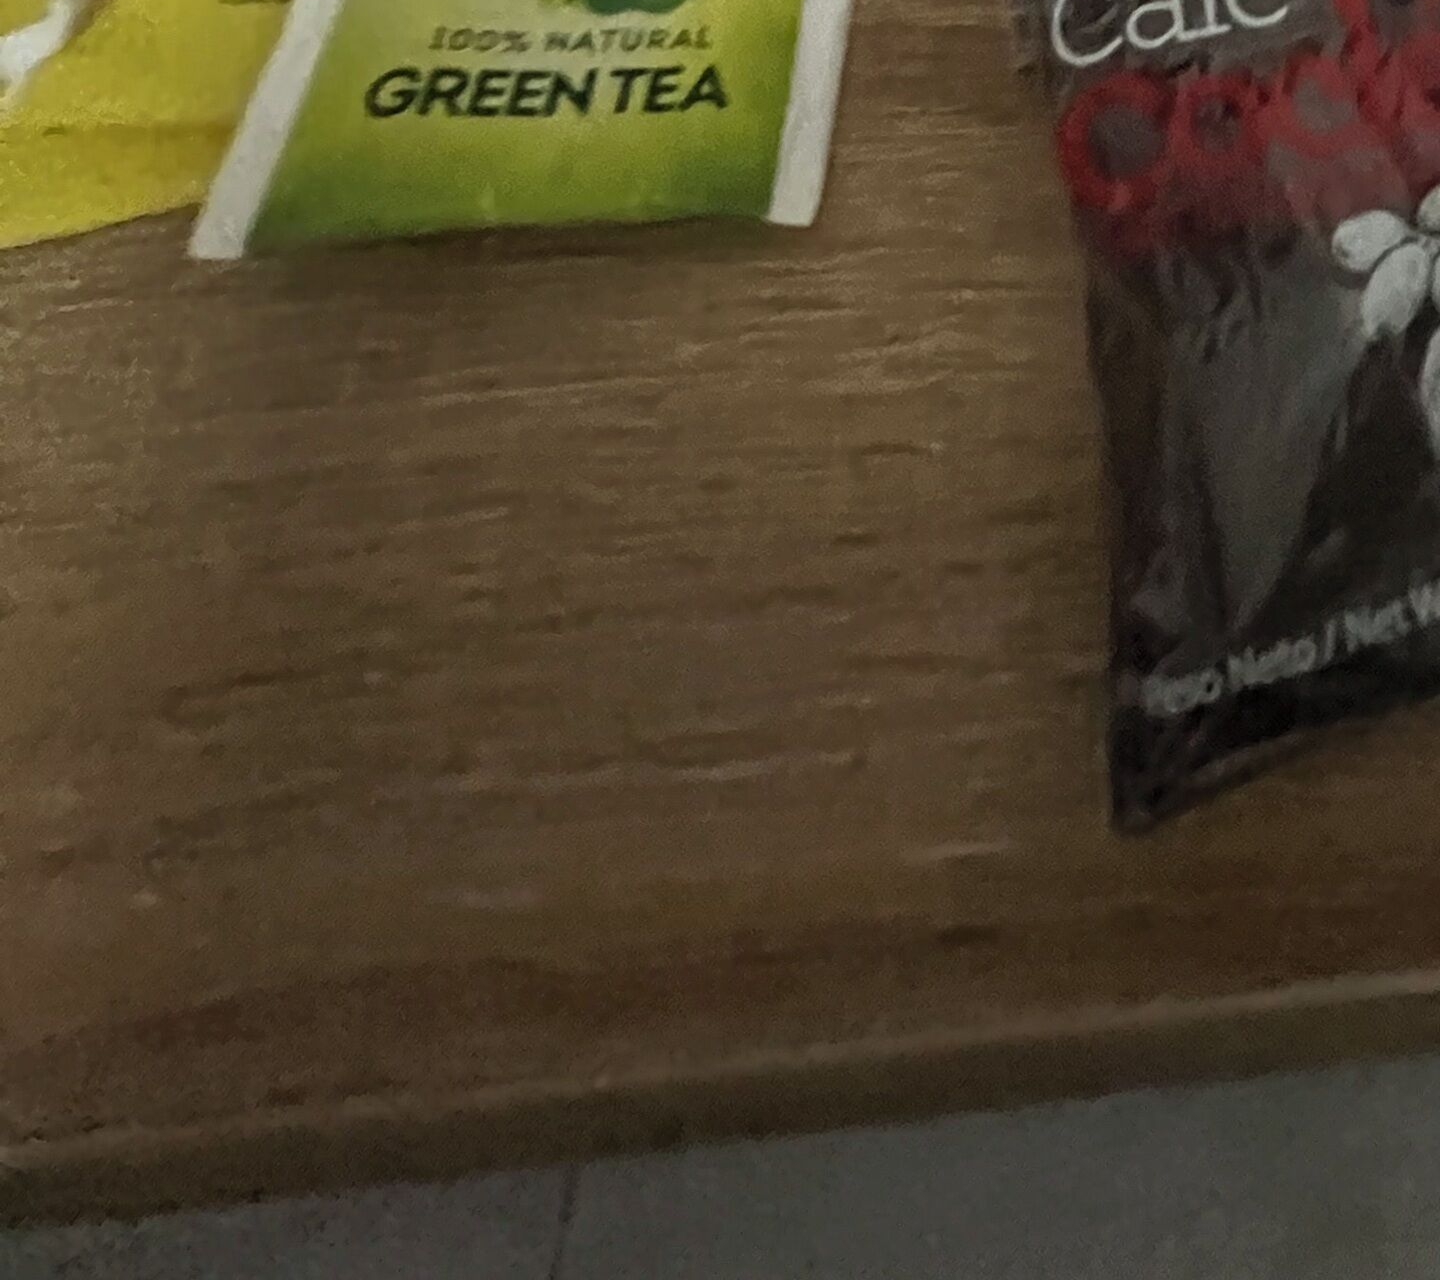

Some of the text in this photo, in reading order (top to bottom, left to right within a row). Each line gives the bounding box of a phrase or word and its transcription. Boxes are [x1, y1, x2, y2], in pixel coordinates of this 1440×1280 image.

[543, 25, 713, 55] NATURAL
[363, 64, 729, 118] GREEN TEA
